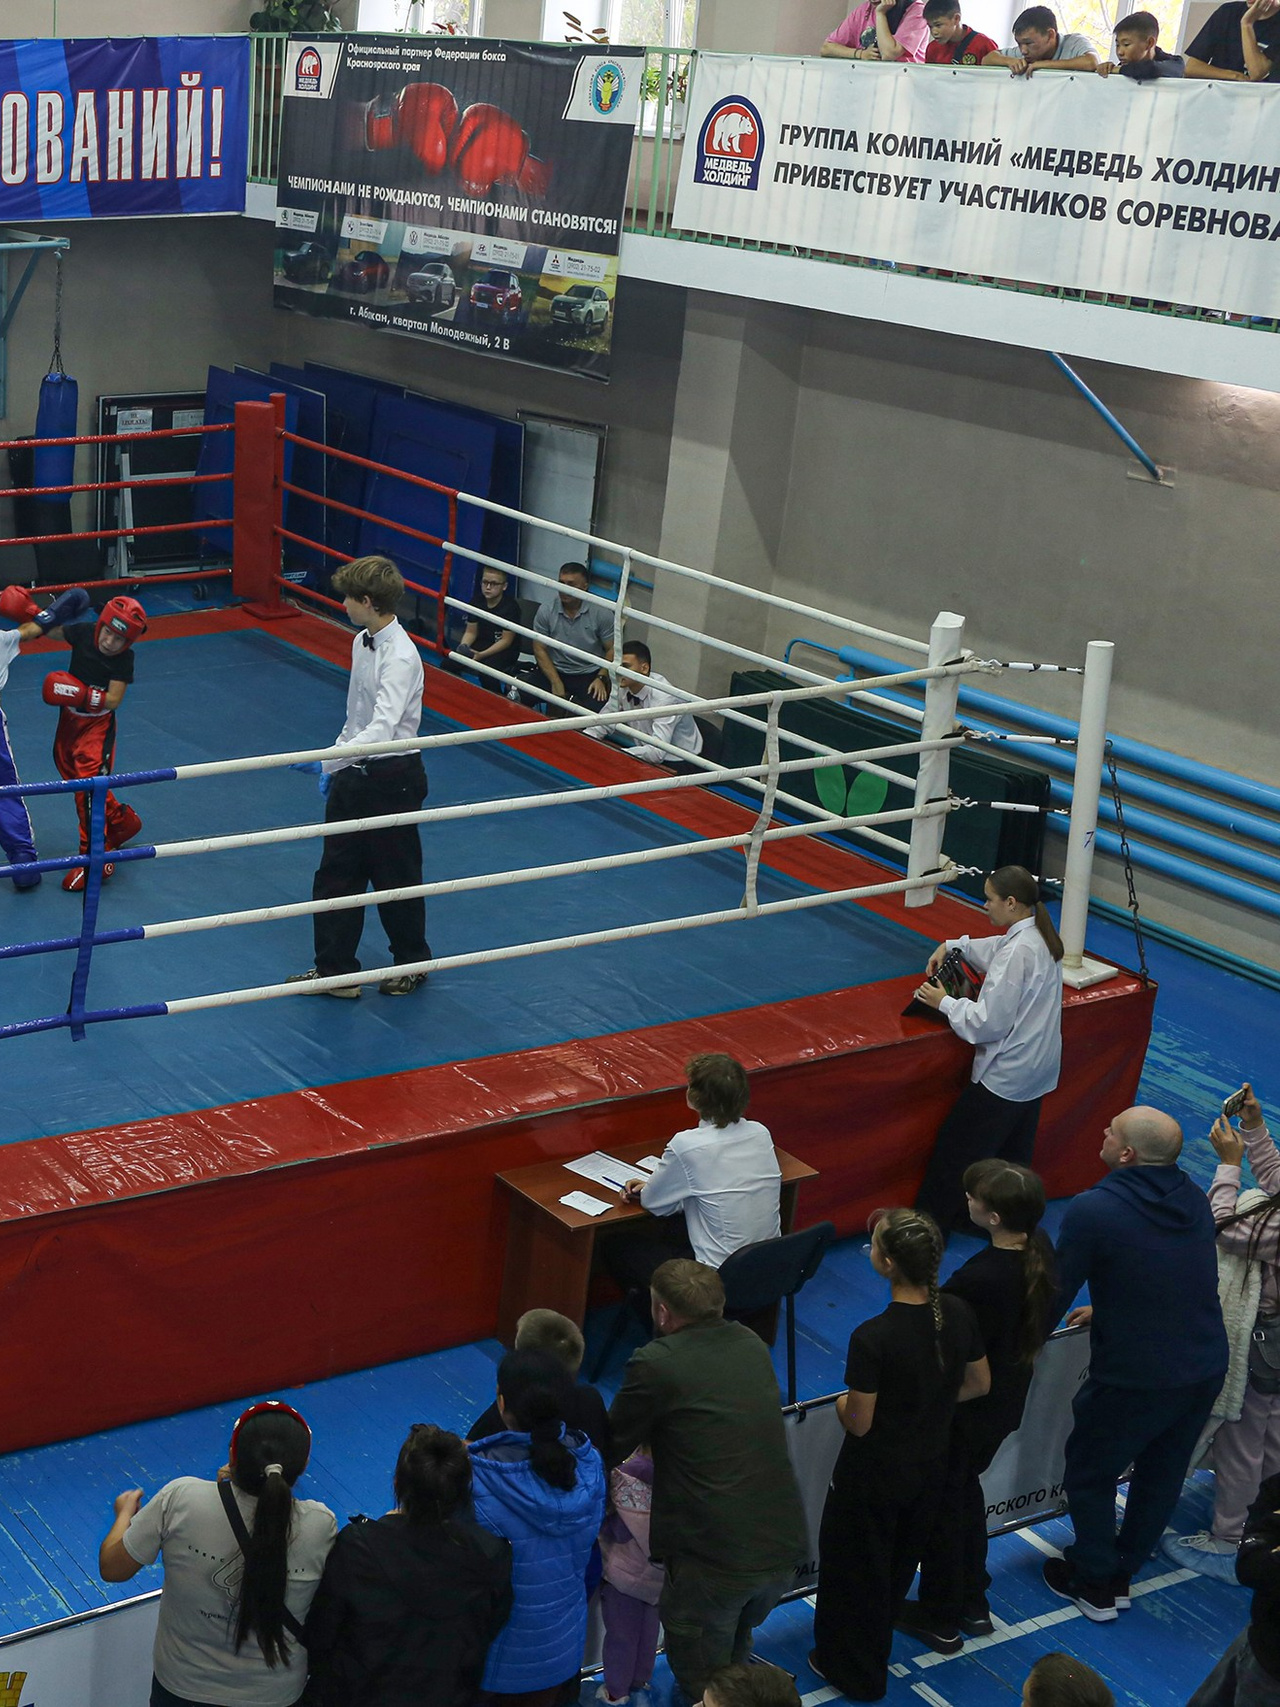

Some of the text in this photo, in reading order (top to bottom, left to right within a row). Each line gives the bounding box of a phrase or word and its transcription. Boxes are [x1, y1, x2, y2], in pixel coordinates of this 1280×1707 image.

[347, 57, 421, 72] Красноярского края
[402, 47, 432, 59] партнер
[434, 47, 480, 61] Федерации
[482, 48, 507, 62] бокса
[704, 157, 753, 174] МЕДВЕДЬ
[779, 123, 1280, 194] ГРУППА КОМПАНИЙ «МЕДВЕДЬ ХОЛДИН
[702, 169, 751, 187] ХОЛДИНГ
[773, 161, 932, 201] ПРИВЕТСТВУЕТ
[938, 180, 1107, 222] УЧАСТНИКОВ
[288, 175, 618, 235] ЧЕМПИОНАМИ НЕ РОЖДАЮТСЯ, ЧЕМПИОНАМИ СТАНОВЯТСЯ!
[349, 306, 356, 316] г.
[392, 316, 428, 332] квартал
[430, 321, 491, 348] Молодежный,
[494, 336, 501, 348] 2
[1083, 830, 1095, 848] 7
[985, 1488, 1047, 1518] РСКОГО
